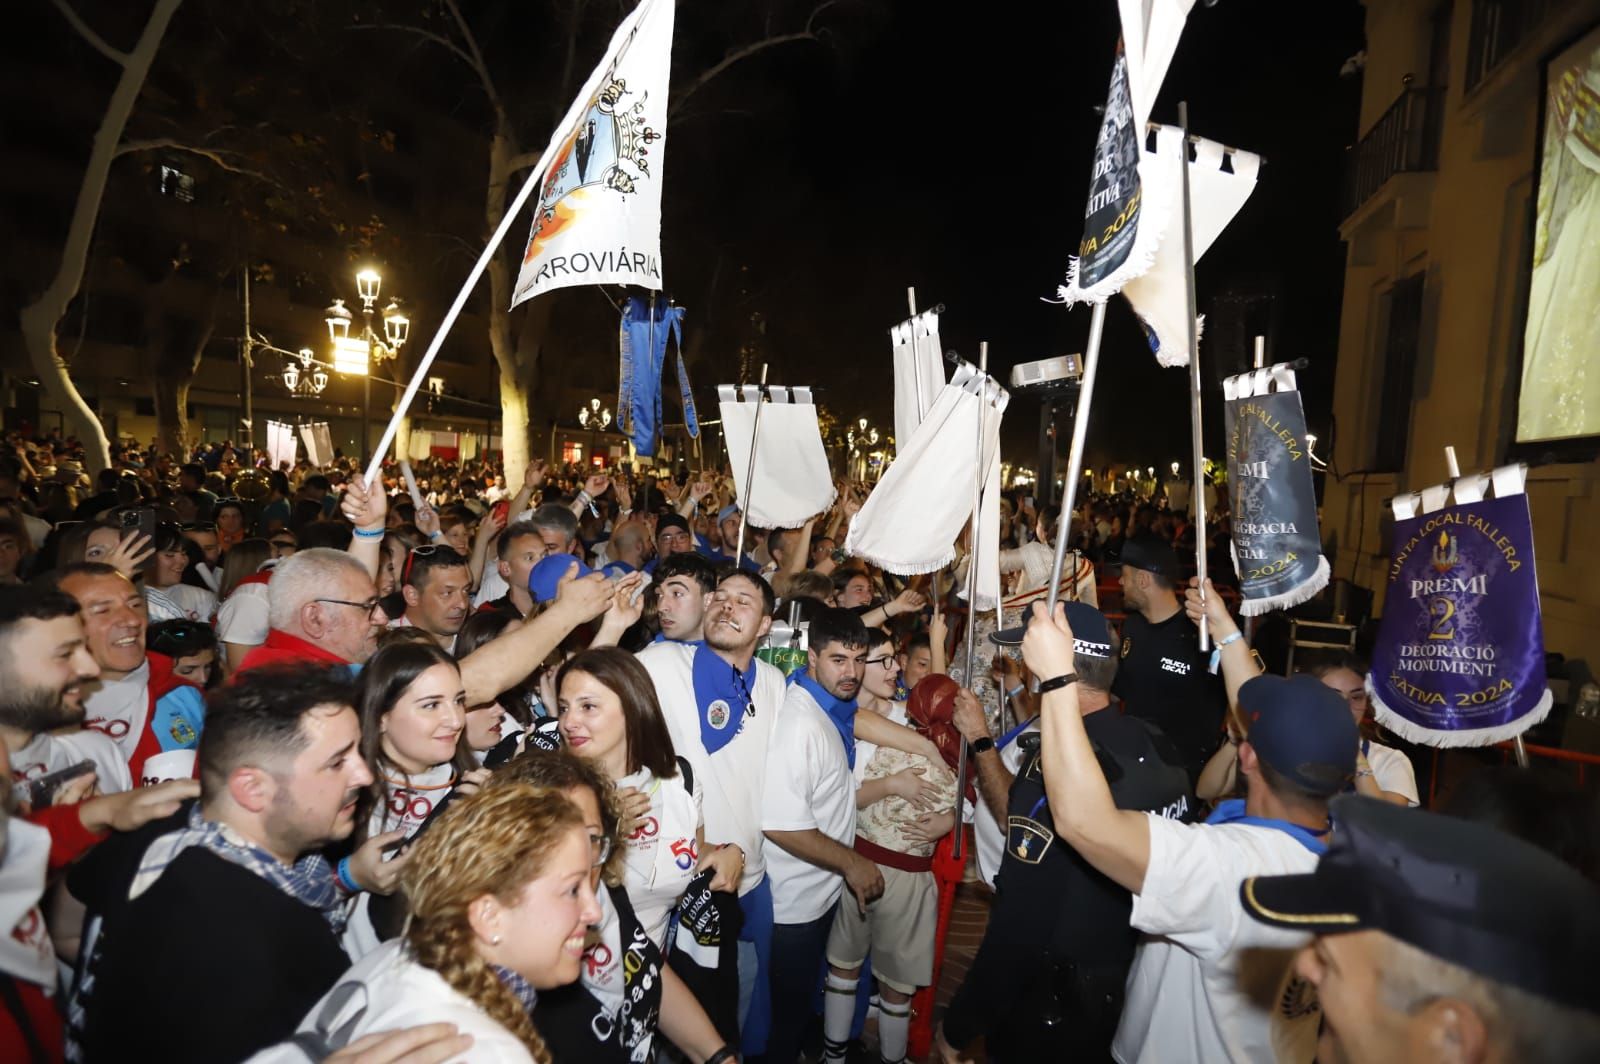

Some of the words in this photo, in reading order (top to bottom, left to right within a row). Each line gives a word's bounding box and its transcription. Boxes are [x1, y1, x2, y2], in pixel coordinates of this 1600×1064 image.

[1101, 190, 1140, 244] 202
[1389, 536, 1420, 581] JUNTA
[1418, 512, 1465, 538] LOCAL
[1467, 513, 1522, 573] FALLERA
[1248, 551, 1298, 580] 2024
[1410, 574, 1489, 599] PREMI
[1428, 597, 1456, 640] 2
[1400, 644, 1495, 662] DECORACIÓ
[1161, 663, 1187, 675] LOCAL
[1397, 659, 1497, 677] MONUMENT
[1455, 678, 1513, 706] 2024
